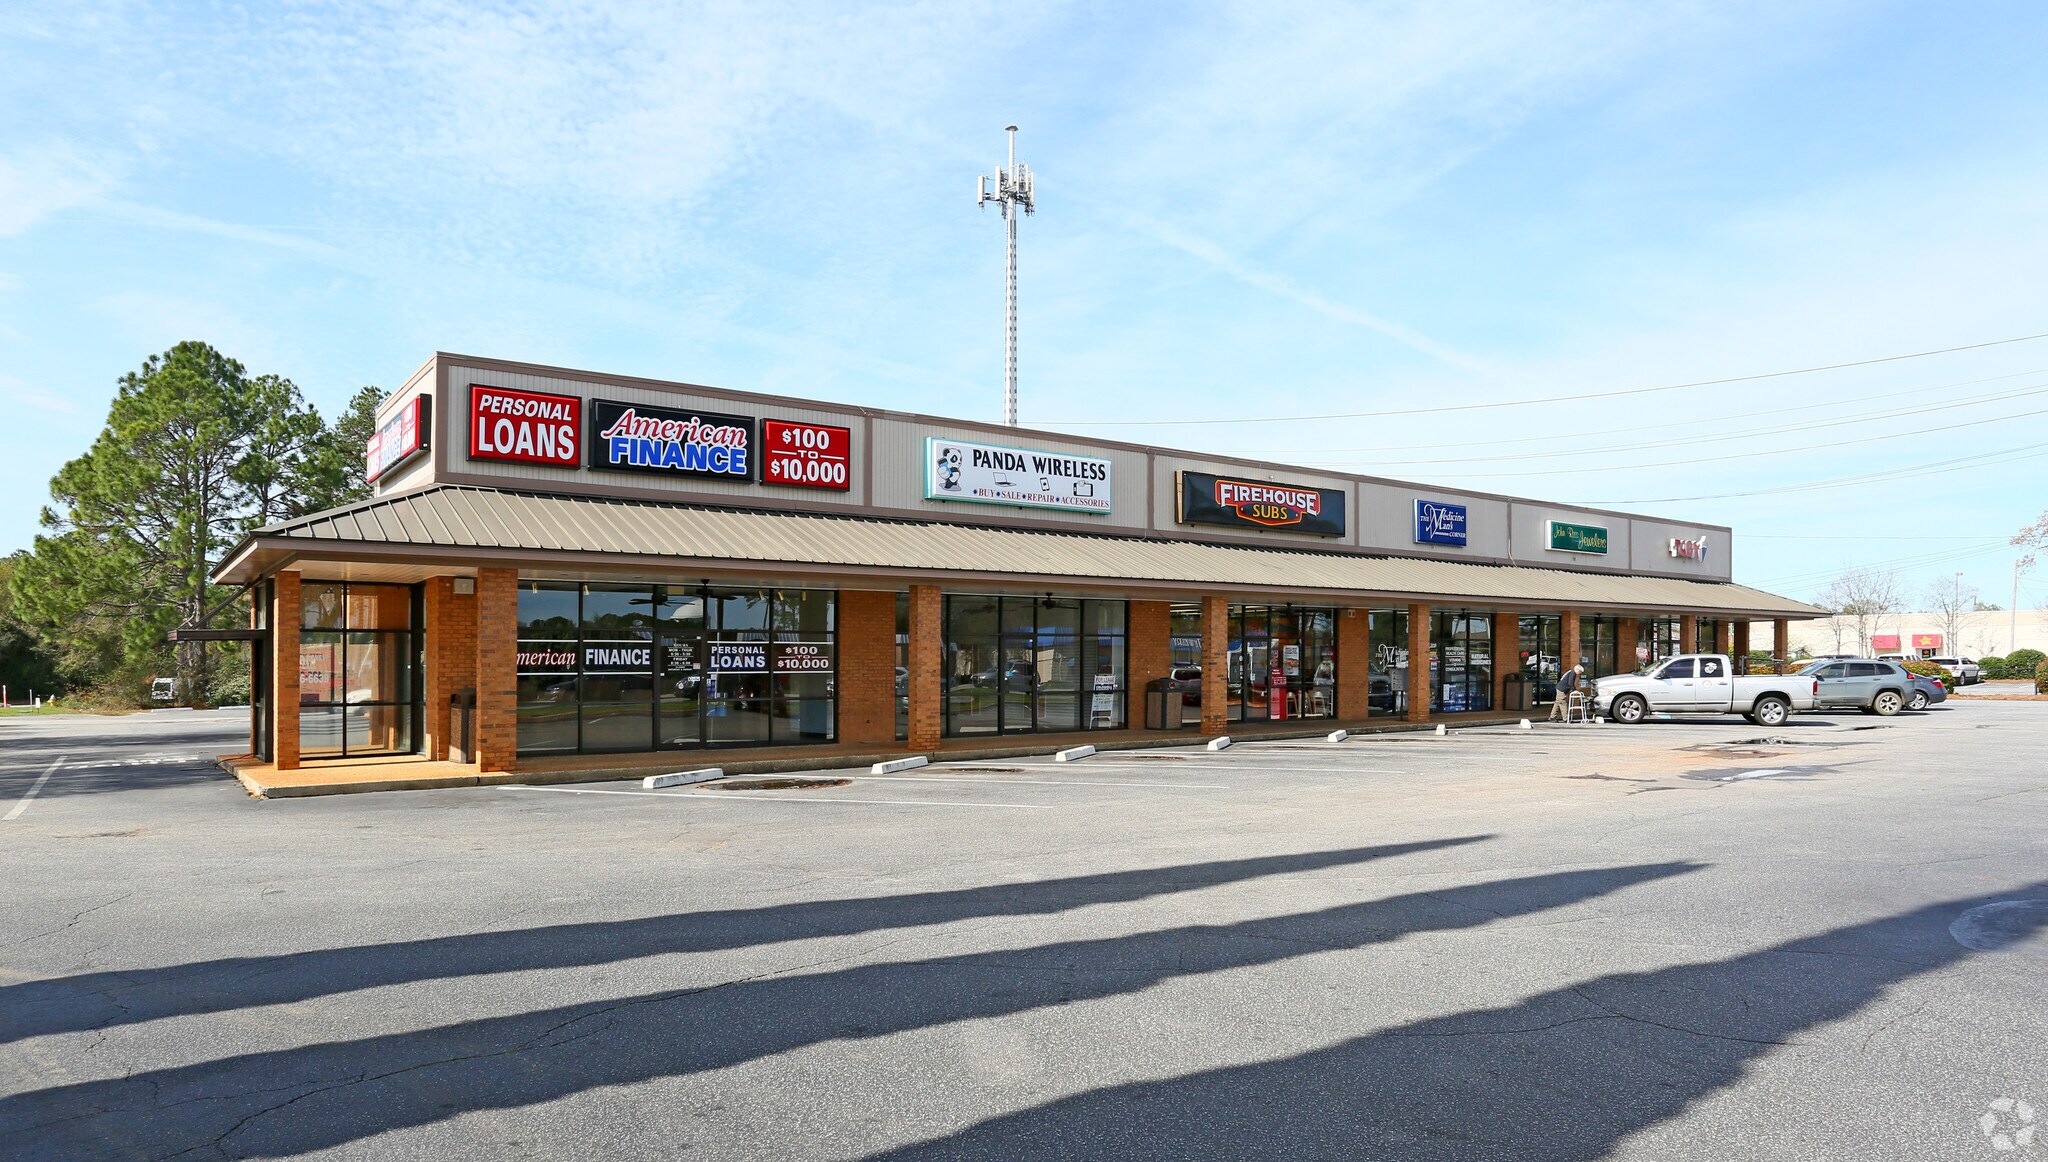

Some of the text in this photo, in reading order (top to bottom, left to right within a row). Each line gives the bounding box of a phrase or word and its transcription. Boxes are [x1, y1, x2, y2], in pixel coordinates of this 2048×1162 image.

[479, 395, 572, 421] PERSONAL
[478, 416, 575, 460] LOANS
[601, 408, 748, 448] American
[782, 428, 830, 450] $100
[609, 436, 747, 475] FINANCE
[797, 449, 819, 460] TO
[973, 448, 1106, 481] PANDA WIRELESS
[770, 458, 846, 484] $10,000
[978, 488, 1110, 509] BUY SALE REPAIR ACCESSORIES
[1220, 484, 1318, 517] FIREHOUSE
[1252, 504, 1288, 520] SUBS
[1424, 504, 1464, 535] Medicine
[516, 648, 651, 666] merican FINANCE
[711, 646, 765, 654] PERSONAL
[785, 646, 818, 655] $100
[710, 655, 766, 668] LOANS
[777, 659, 829, 669] $10,000
